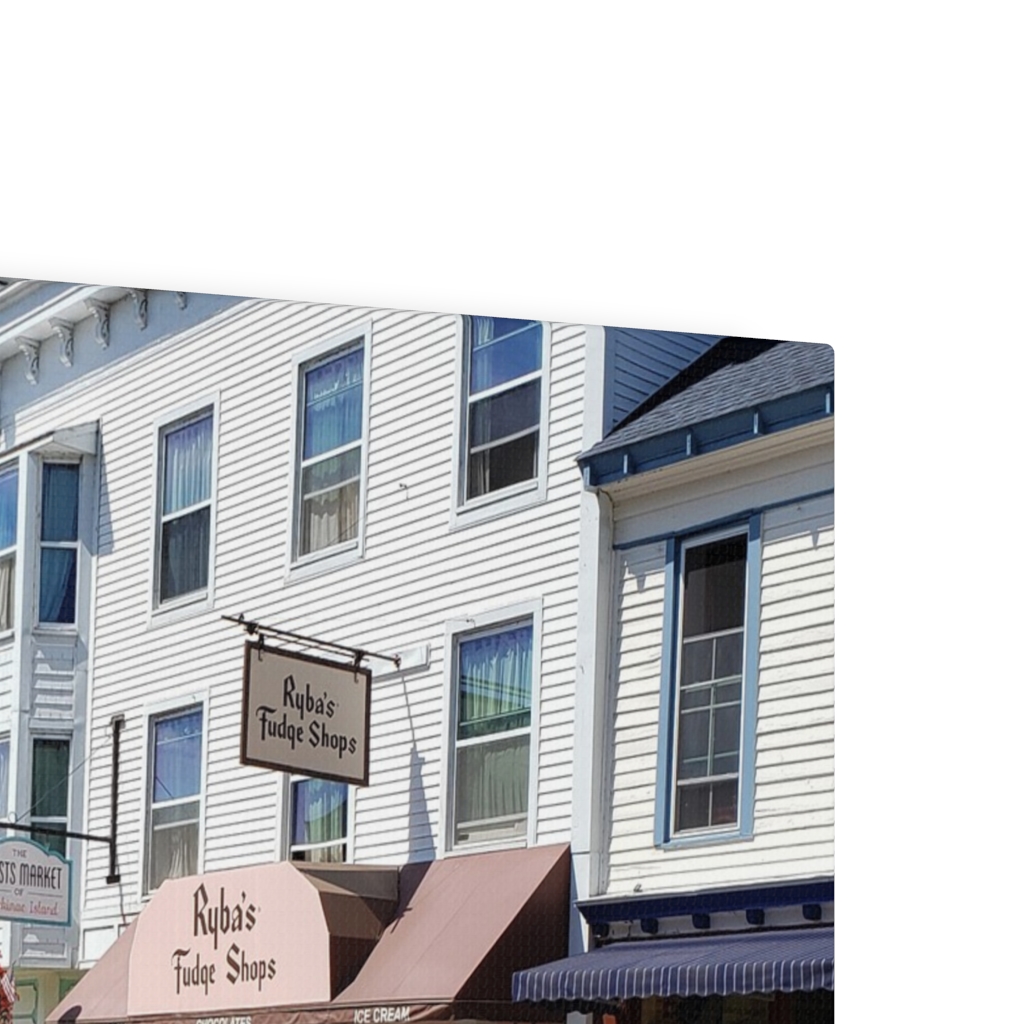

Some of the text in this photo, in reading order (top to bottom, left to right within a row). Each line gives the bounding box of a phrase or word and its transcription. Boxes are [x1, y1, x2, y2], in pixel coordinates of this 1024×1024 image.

[283, 674, 336, 720] Ryba's
[256, 705, 358, 759] Fudge Shops
[12, 848, 27, 858] THE
[19, 862, 63, 889] MARKET
[13, 888, 24, 896] OF
[29, 900, 59, 915] Island
[193, 882, 257, 950] Ryba's
[171, 942, 276, 995] Fudge Shops
[354, 1006, 410, 1024] ICE CREAM
